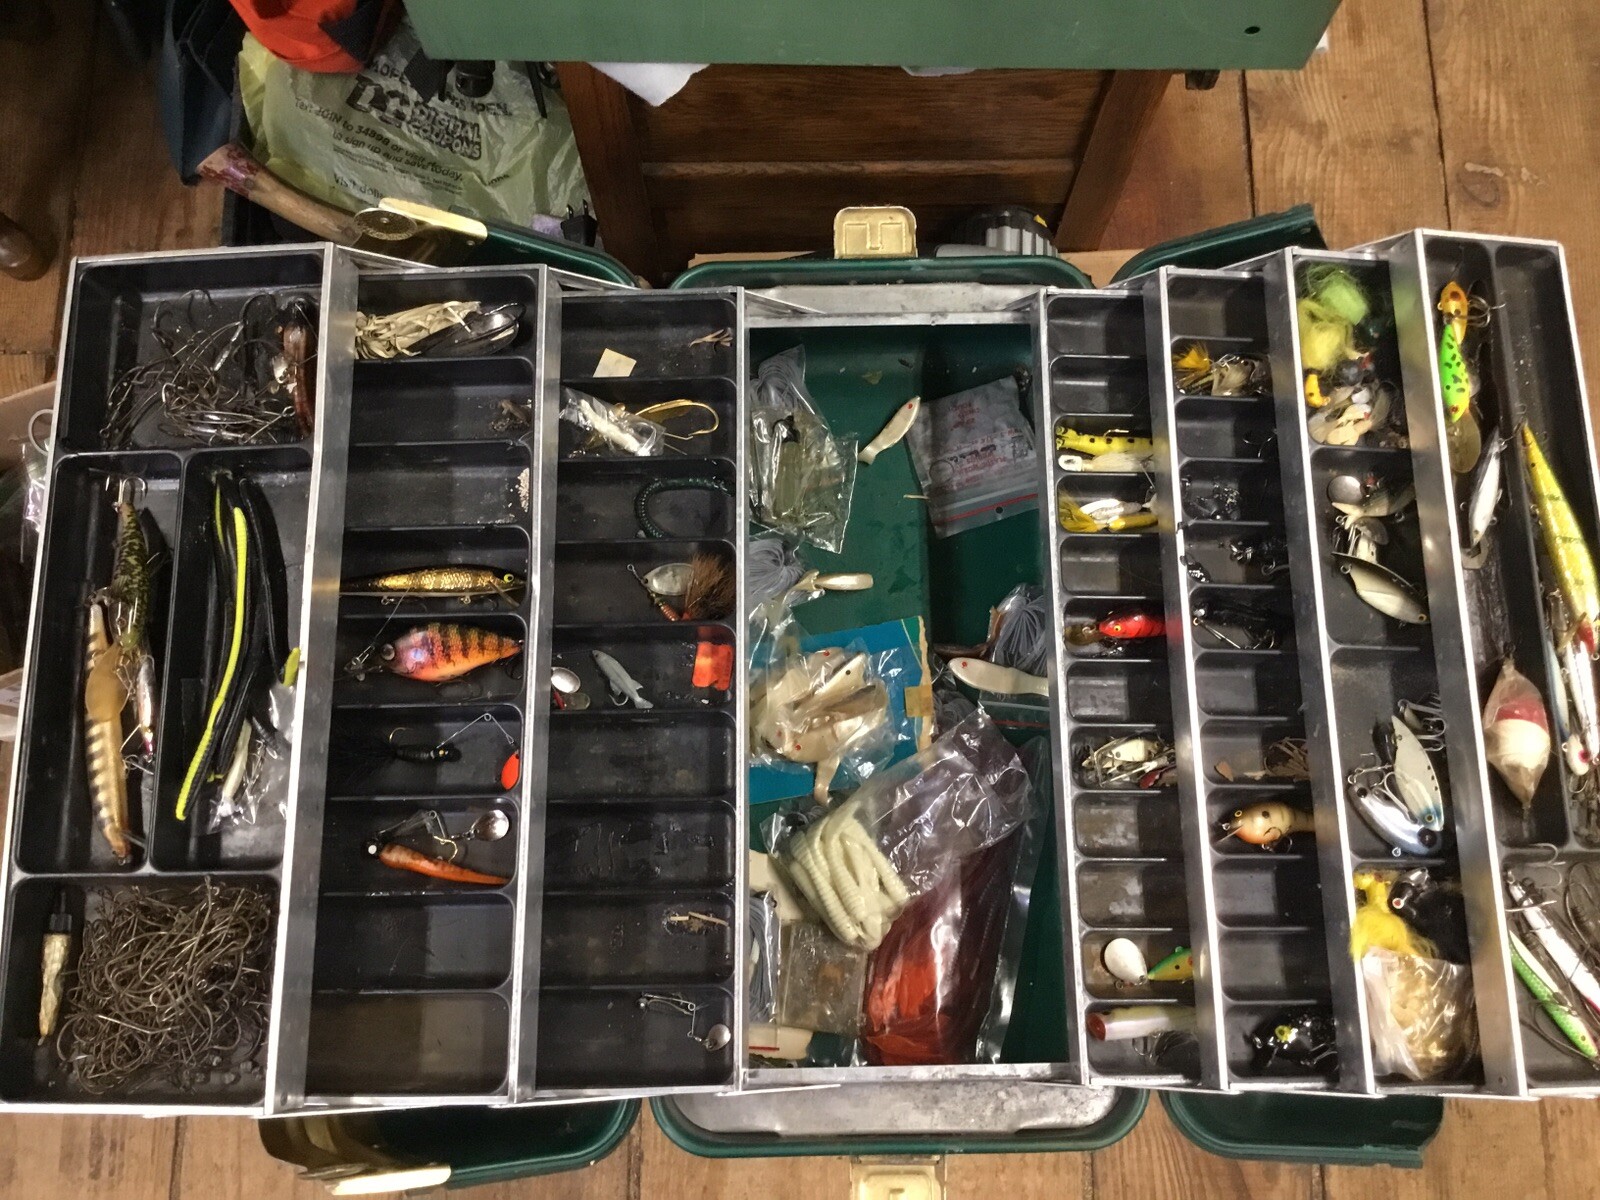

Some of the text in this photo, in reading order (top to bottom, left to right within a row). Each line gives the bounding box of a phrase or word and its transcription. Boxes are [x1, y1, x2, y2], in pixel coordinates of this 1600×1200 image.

[295, 97, 313, 112] Text
[316, 107, 342, 123] JOIN
[343, 120, 354, 131] to
[391, 143, 404, 153] or
[408, 121, 482, 160] COUPONS
[411, 102, 481, 141] DIGITAL
[344, 136, 366, 149] sign
[430, 162, 463, 181] today.
